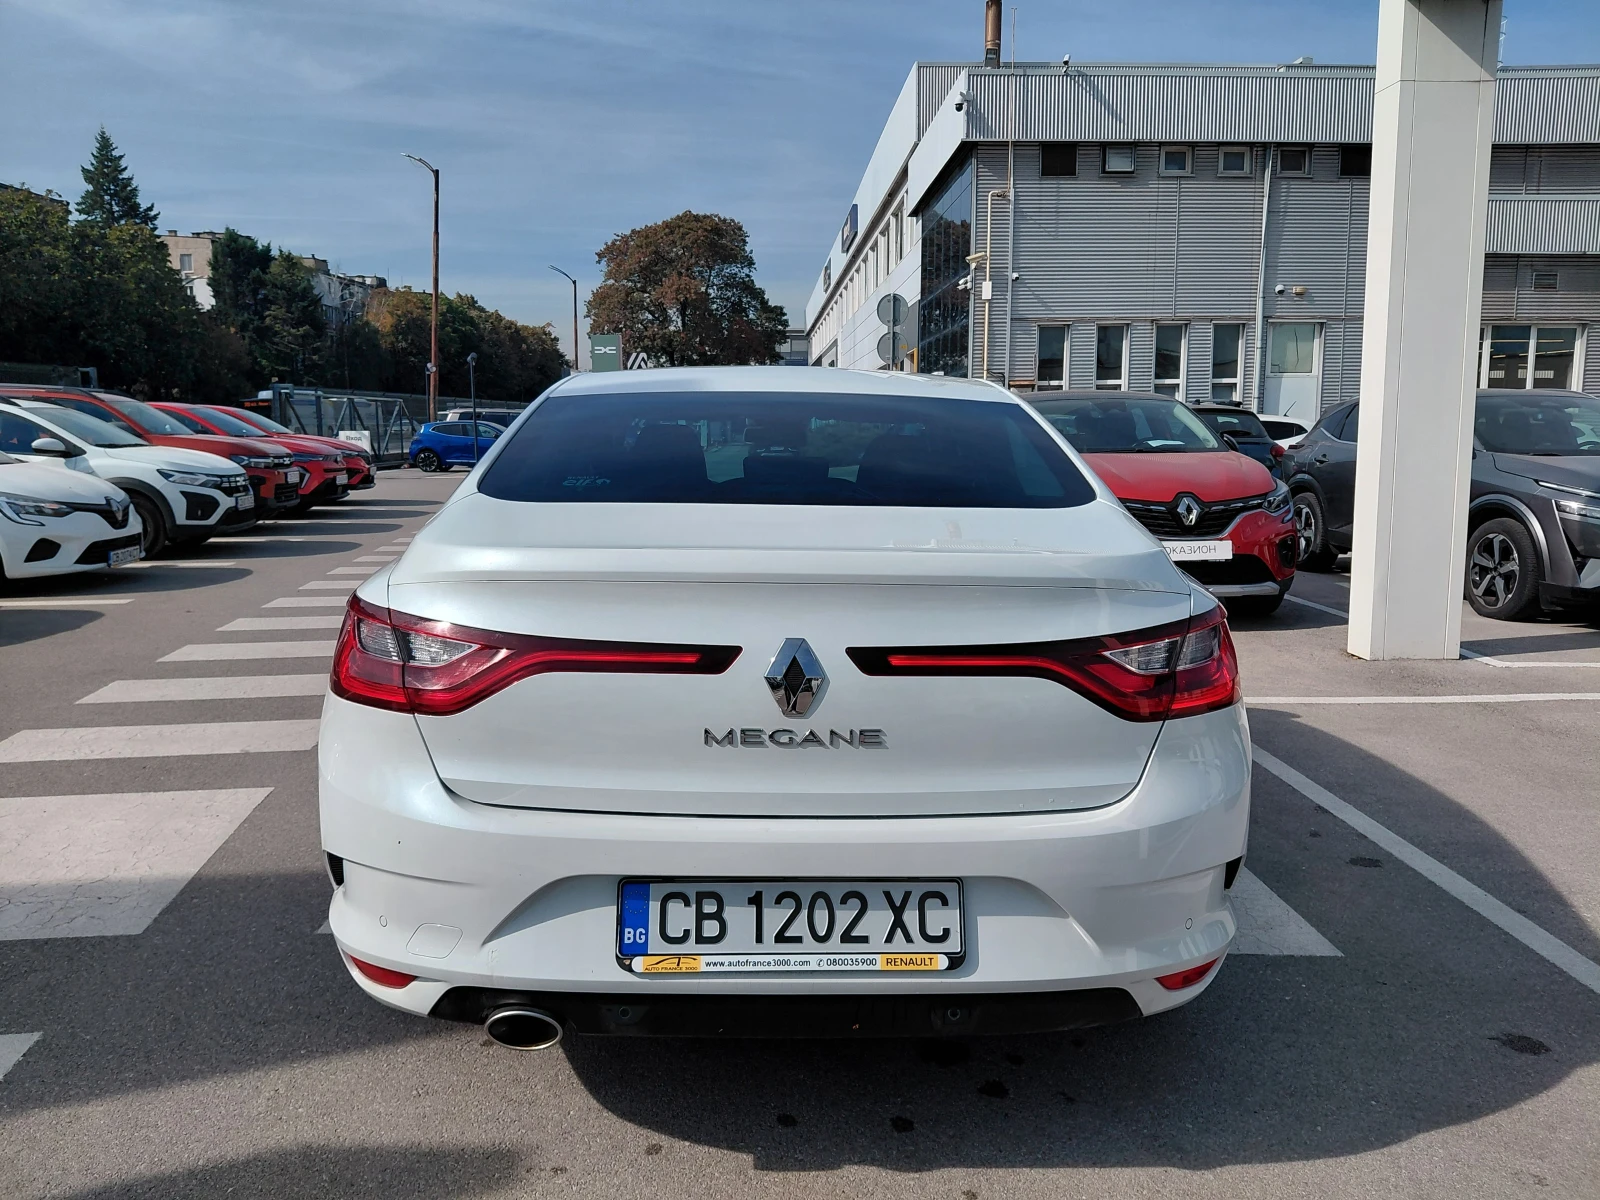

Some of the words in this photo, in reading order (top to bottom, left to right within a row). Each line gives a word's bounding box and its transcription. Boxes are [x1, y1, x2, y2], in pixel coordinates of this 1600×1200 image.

[703, 727, 884, 747] MEGANE
[658, 890, 728, 945] CB
[747, 890, 870, 944] 1202
[881, 890, 951, 944] XC
[624, 927, 646, 944] BG
[704, 957, 811, 967] www.autofrance3000.com
[826, 957, 877, 967] 080035900
[885, 957, 935, 967] RENAULT
